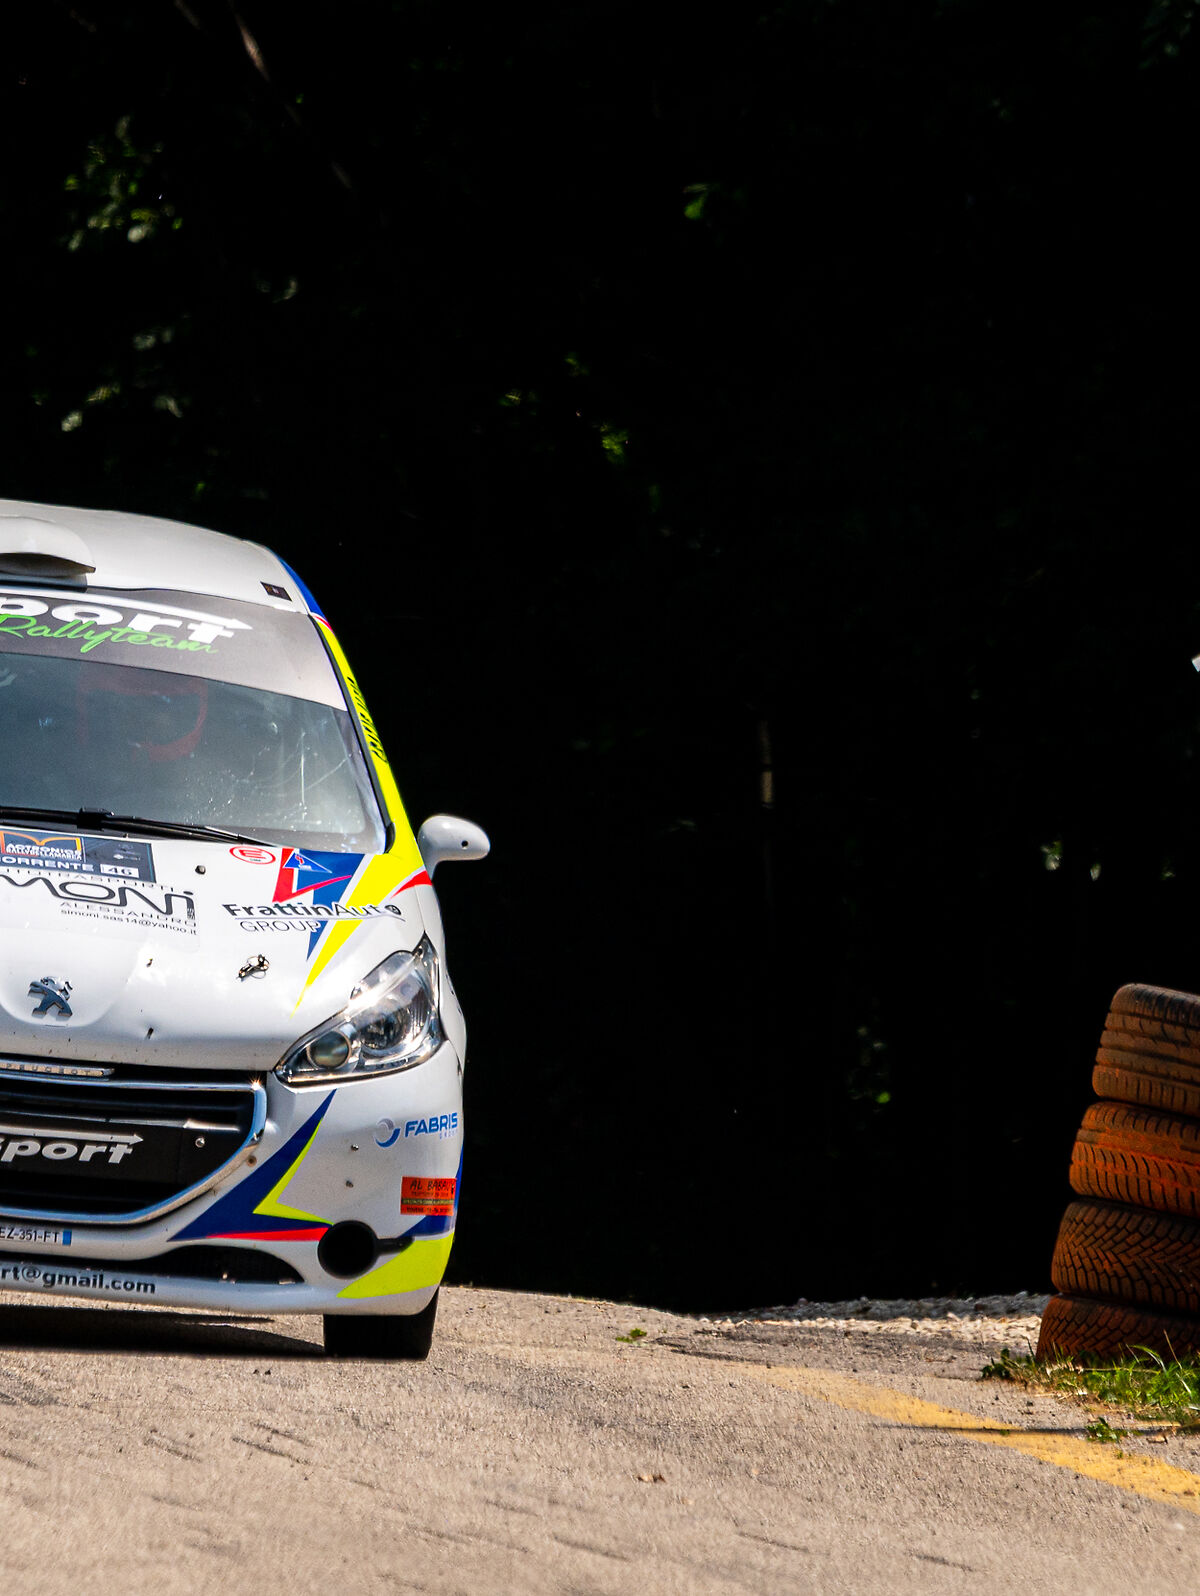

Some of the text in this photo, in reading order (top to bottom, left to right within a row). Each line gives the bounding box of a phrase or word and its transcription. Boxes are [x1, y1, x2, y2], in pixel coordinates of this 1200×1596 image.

[108, 866, 133, 876] 46
[60, 901, 197, 927] ALESSANDRO
[239, 920, 321, 933] GROUP
[5, 1062, 92, 1077] PEUGEOT
[404, 1112, 458, 1138] FABRIS
